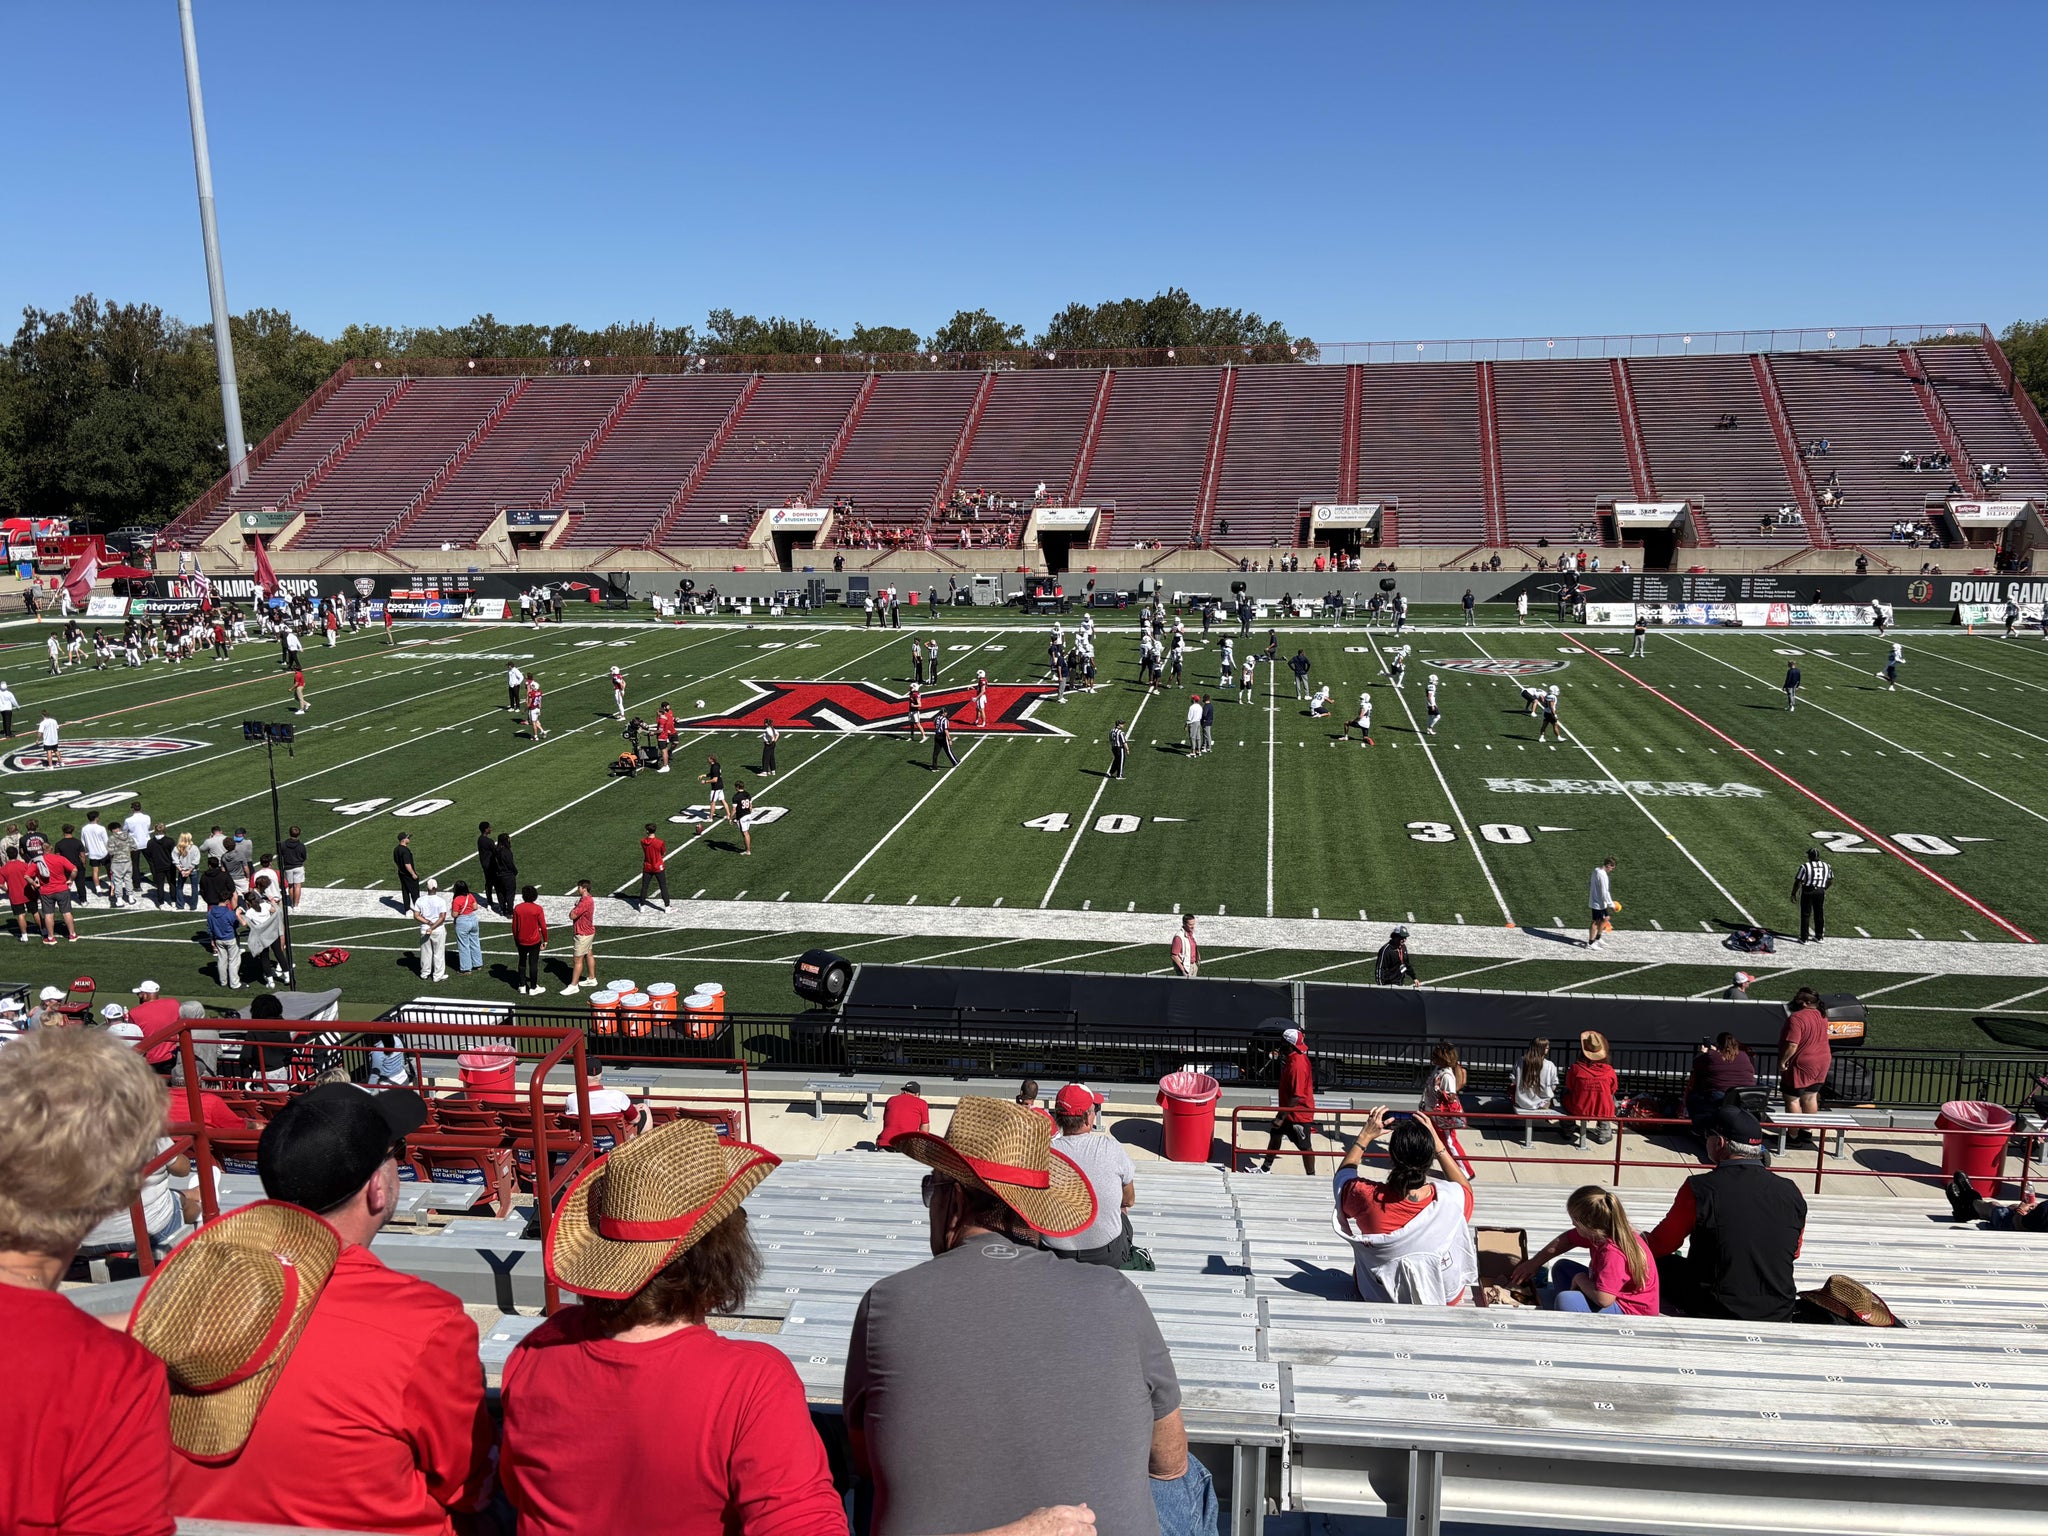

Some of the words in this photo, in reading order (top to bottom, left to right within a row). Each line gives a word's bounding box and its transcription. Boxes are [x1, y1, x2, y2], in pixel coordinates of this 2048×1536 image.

[1950, 581, 2001, 602] BOWL
[137, 601, 198, 613] enterprise
[332, 797, 456, 818] 40
[1022, 812, 1143, 834] 40
[1406, 821, 1534, 845] 30
[1809, 830, 1963, 856] 20
[1813, 867, 1824, 880] H
[653, 1001, 661, 1010] G
[1430, 1392, 1445, 1400] 28
[1597, 1402, 1612, 1410] 27
[1933, 1418, 1949, 1426] 25
